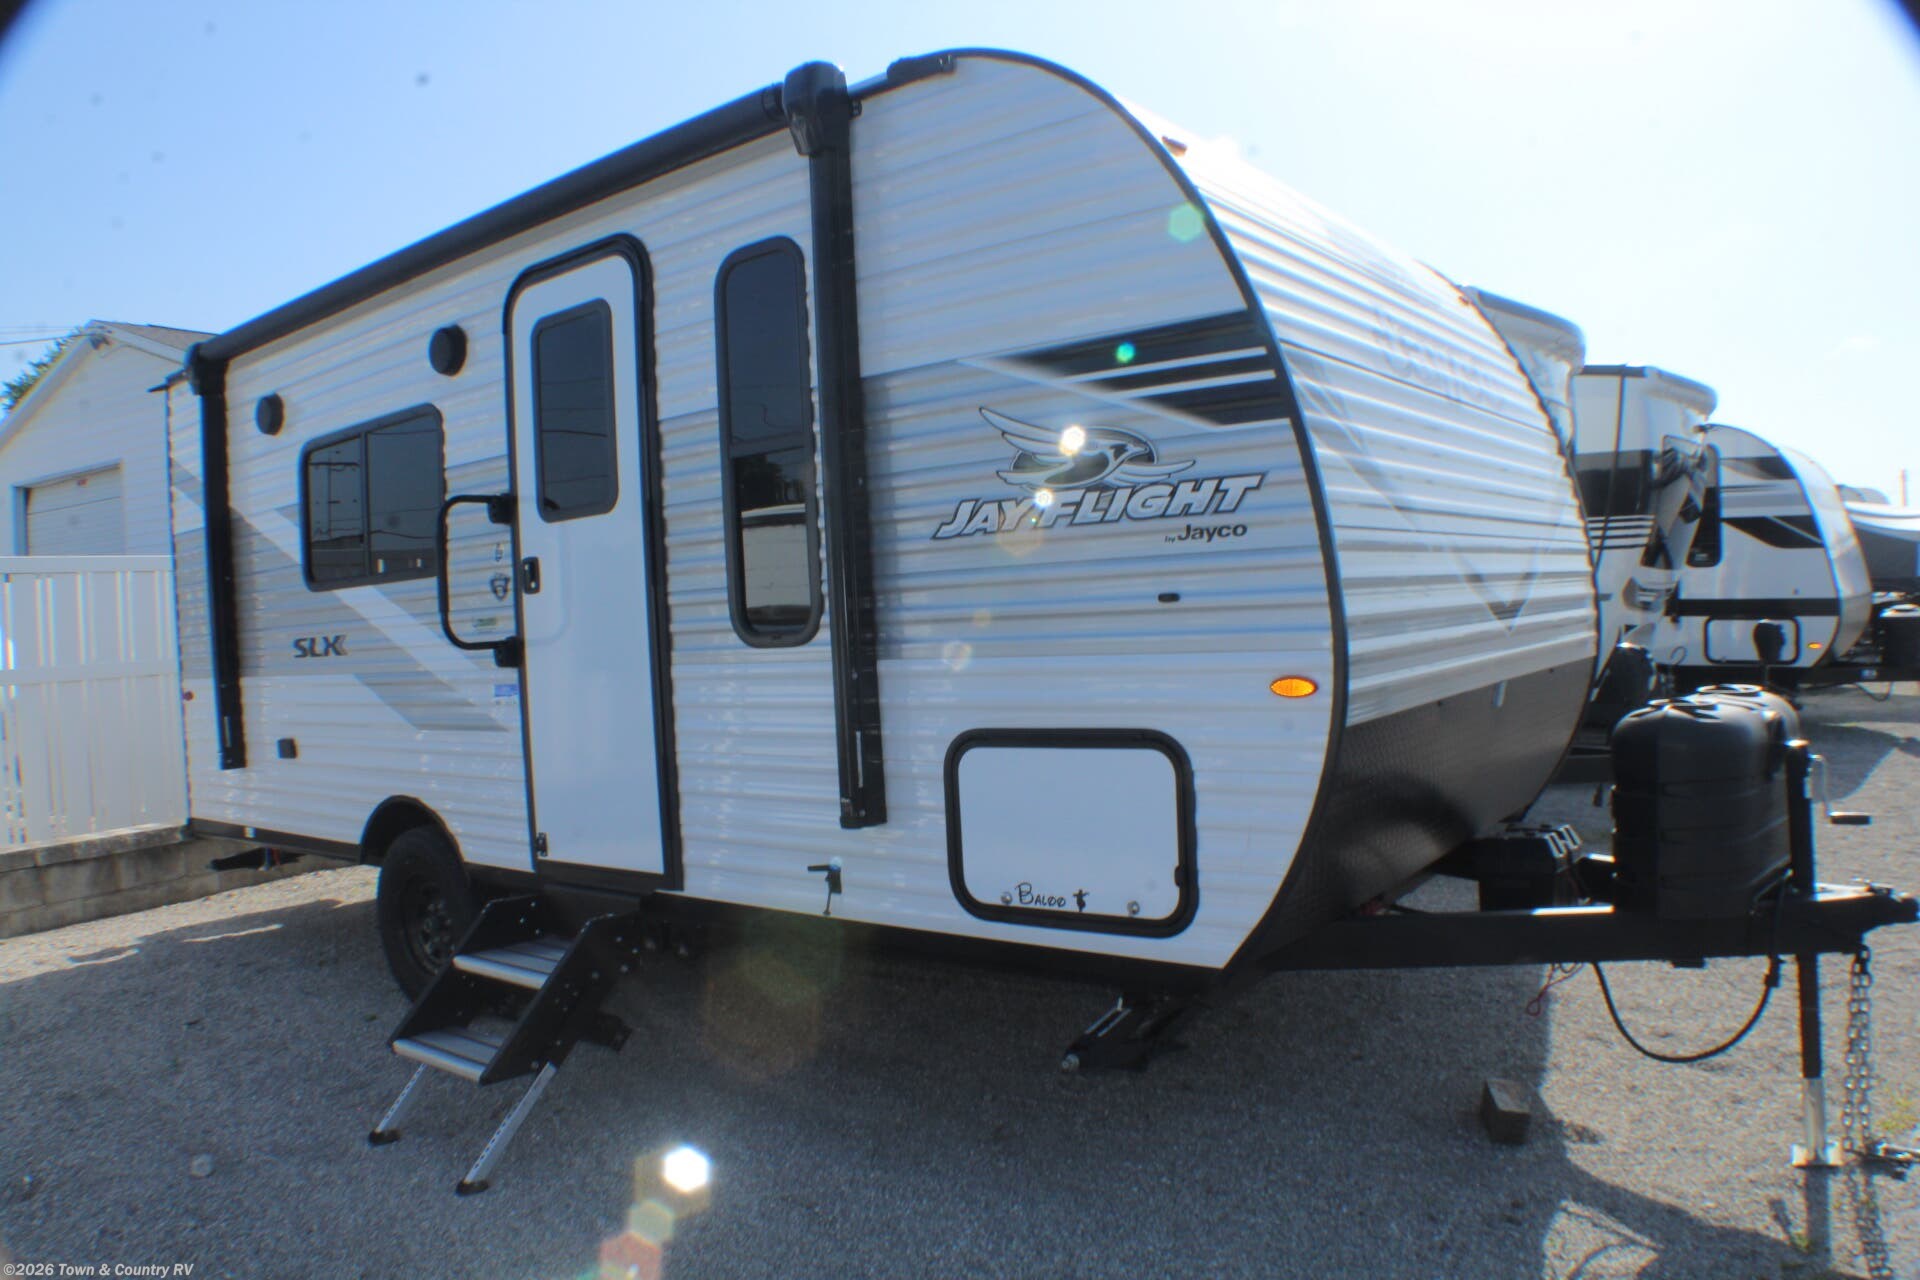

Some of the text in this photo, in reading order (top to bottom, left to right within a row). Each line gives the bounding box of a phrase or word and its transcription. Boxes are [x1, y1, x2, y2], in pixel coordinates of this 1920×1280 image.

[930, 471, 1268, 540] JAY FLIGHT
[1177, 524, 1248, 543] Jayco
